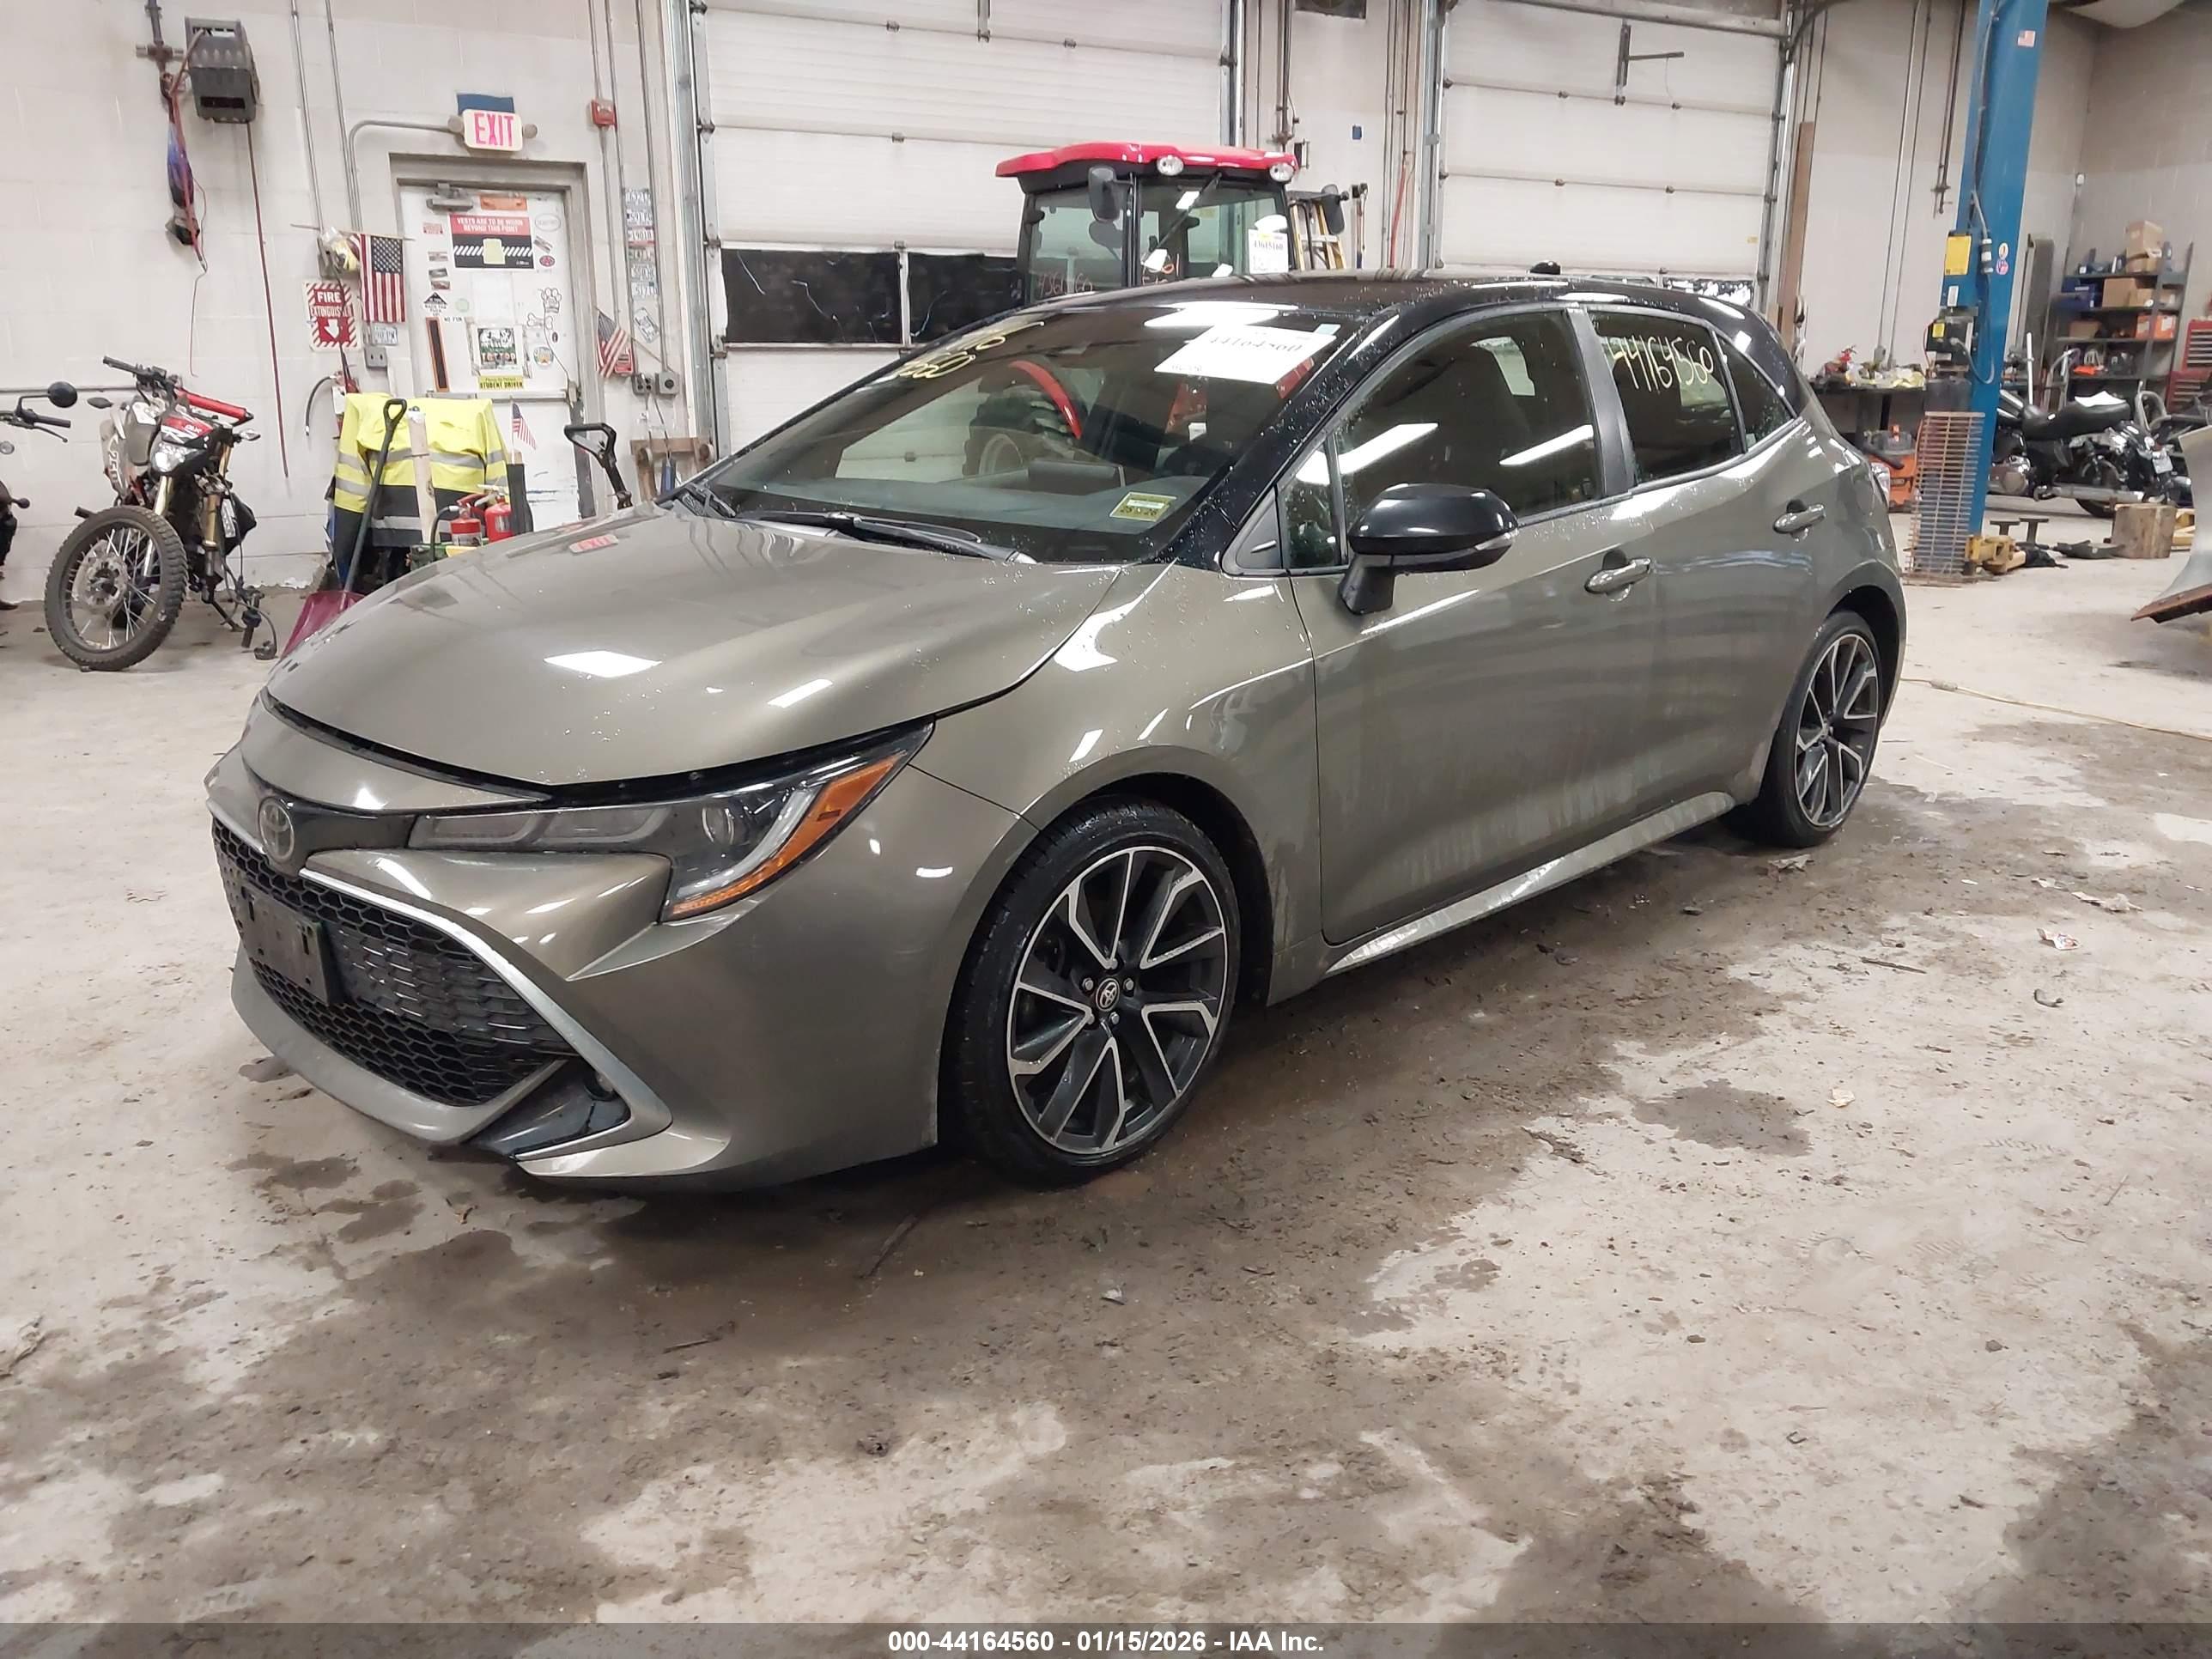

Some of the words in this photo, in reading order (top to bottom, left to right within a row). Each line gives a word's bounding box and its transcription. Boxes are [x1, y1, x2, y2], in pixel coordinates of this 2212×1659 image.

[473, 112, 514, 147] EXIT
[317, 291, 342, 303] FIRE
[1605, 334, 1714, 395] 44164560
